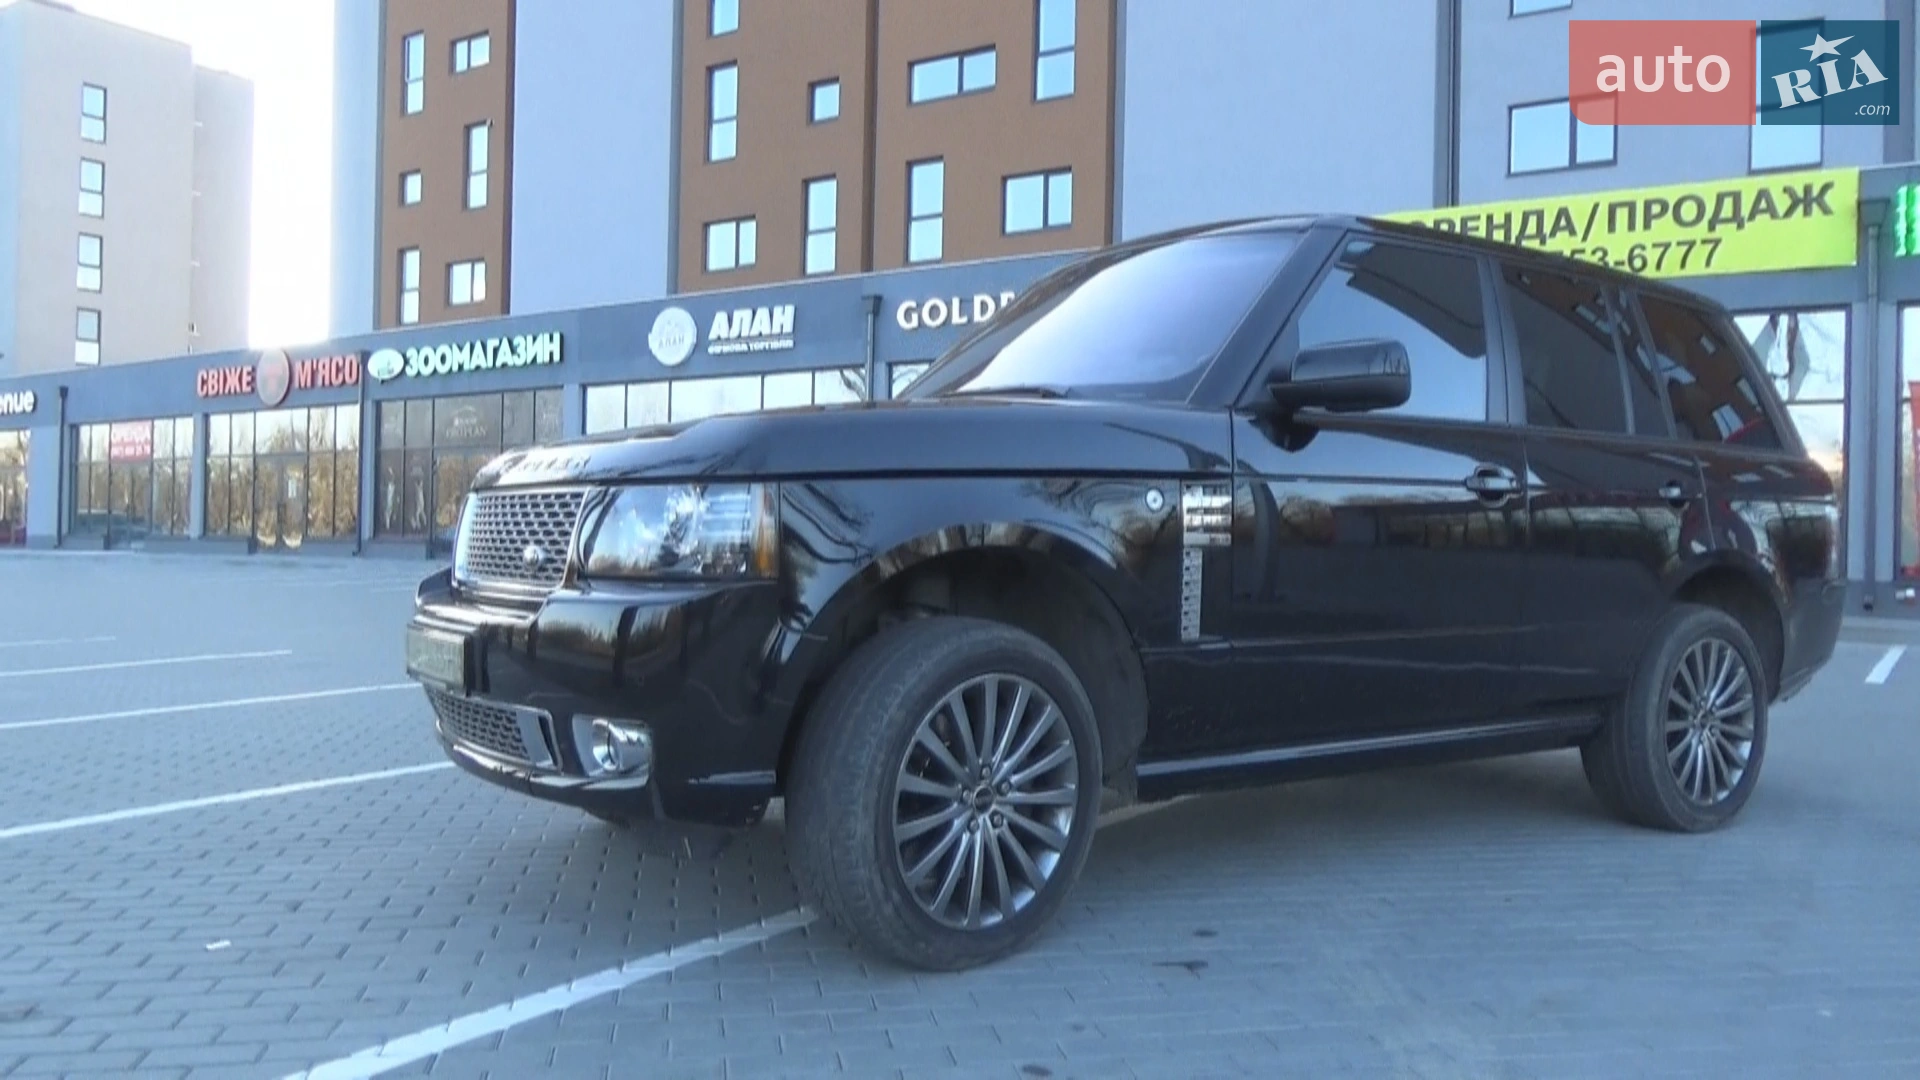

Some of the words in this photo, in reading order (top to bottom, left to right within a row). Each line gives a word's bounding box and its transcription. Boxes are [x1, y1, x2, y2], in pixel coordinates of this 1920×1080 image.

[708, 304, 795, 341] АЛАН
[197, 365, 253, 397] СВІЖЕ
[295, 353, 361, 388] М'ЯСО
[405, 331, 563, 378] ЗООМАГАЗИН
